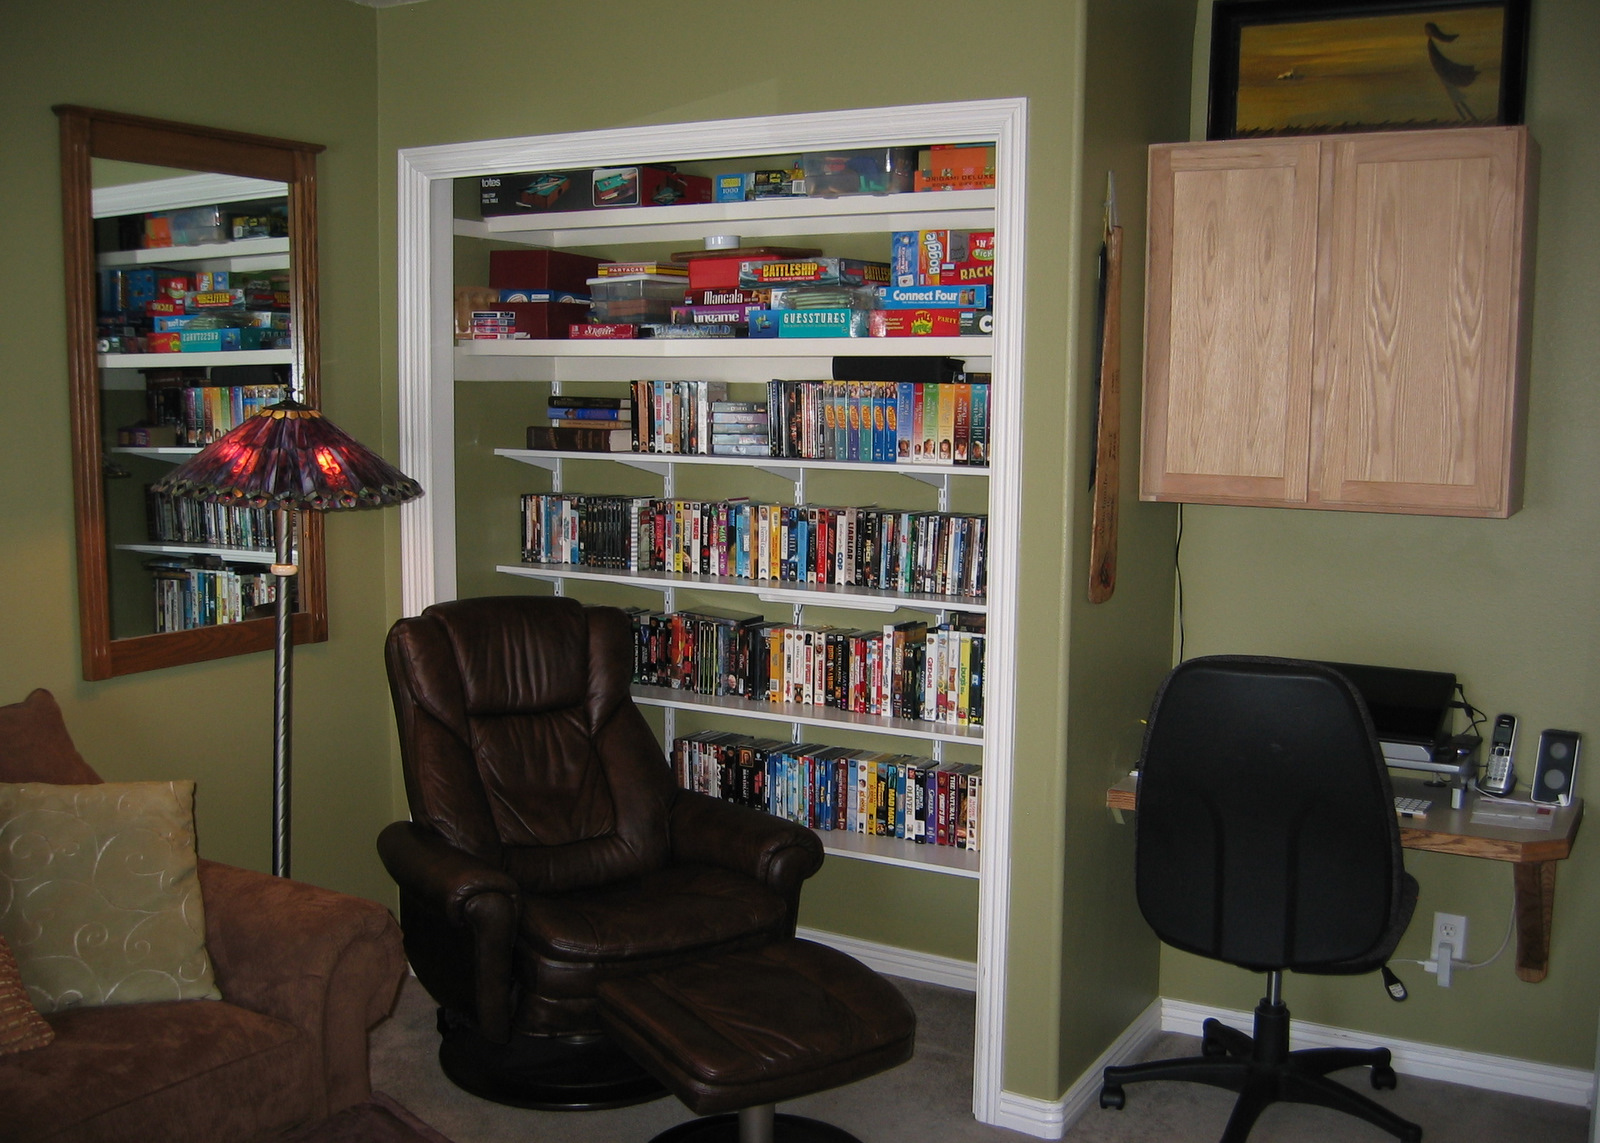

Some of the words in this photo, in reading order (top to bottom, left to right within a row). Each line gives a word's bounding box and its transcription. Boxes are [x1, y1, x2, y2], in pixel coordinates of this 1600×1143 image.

[975, 240, 987, 248] IN
[924, 232, 943, 275] Boggle
[975, 249, 993, 257] PICK
[763, 263, 818, 278] BATTLESHIP
[863, 266, 891, 281] BATTLES
[960, 265, 993, 280] RACK
[703, 289, 743, 305] Mancala
[893, 290, 933, 301] Connect
[935, 290, 958, 301] Four
[693, 312, 740, 324] ungame
[783, 313, 846, 324] GUESSTURES
[937, 316, 958, 324] PARTY
[719, 525, 727, 543] MASK
[960, 667, 968, 686] bug's
[887, 807, 895, 825] MAX
